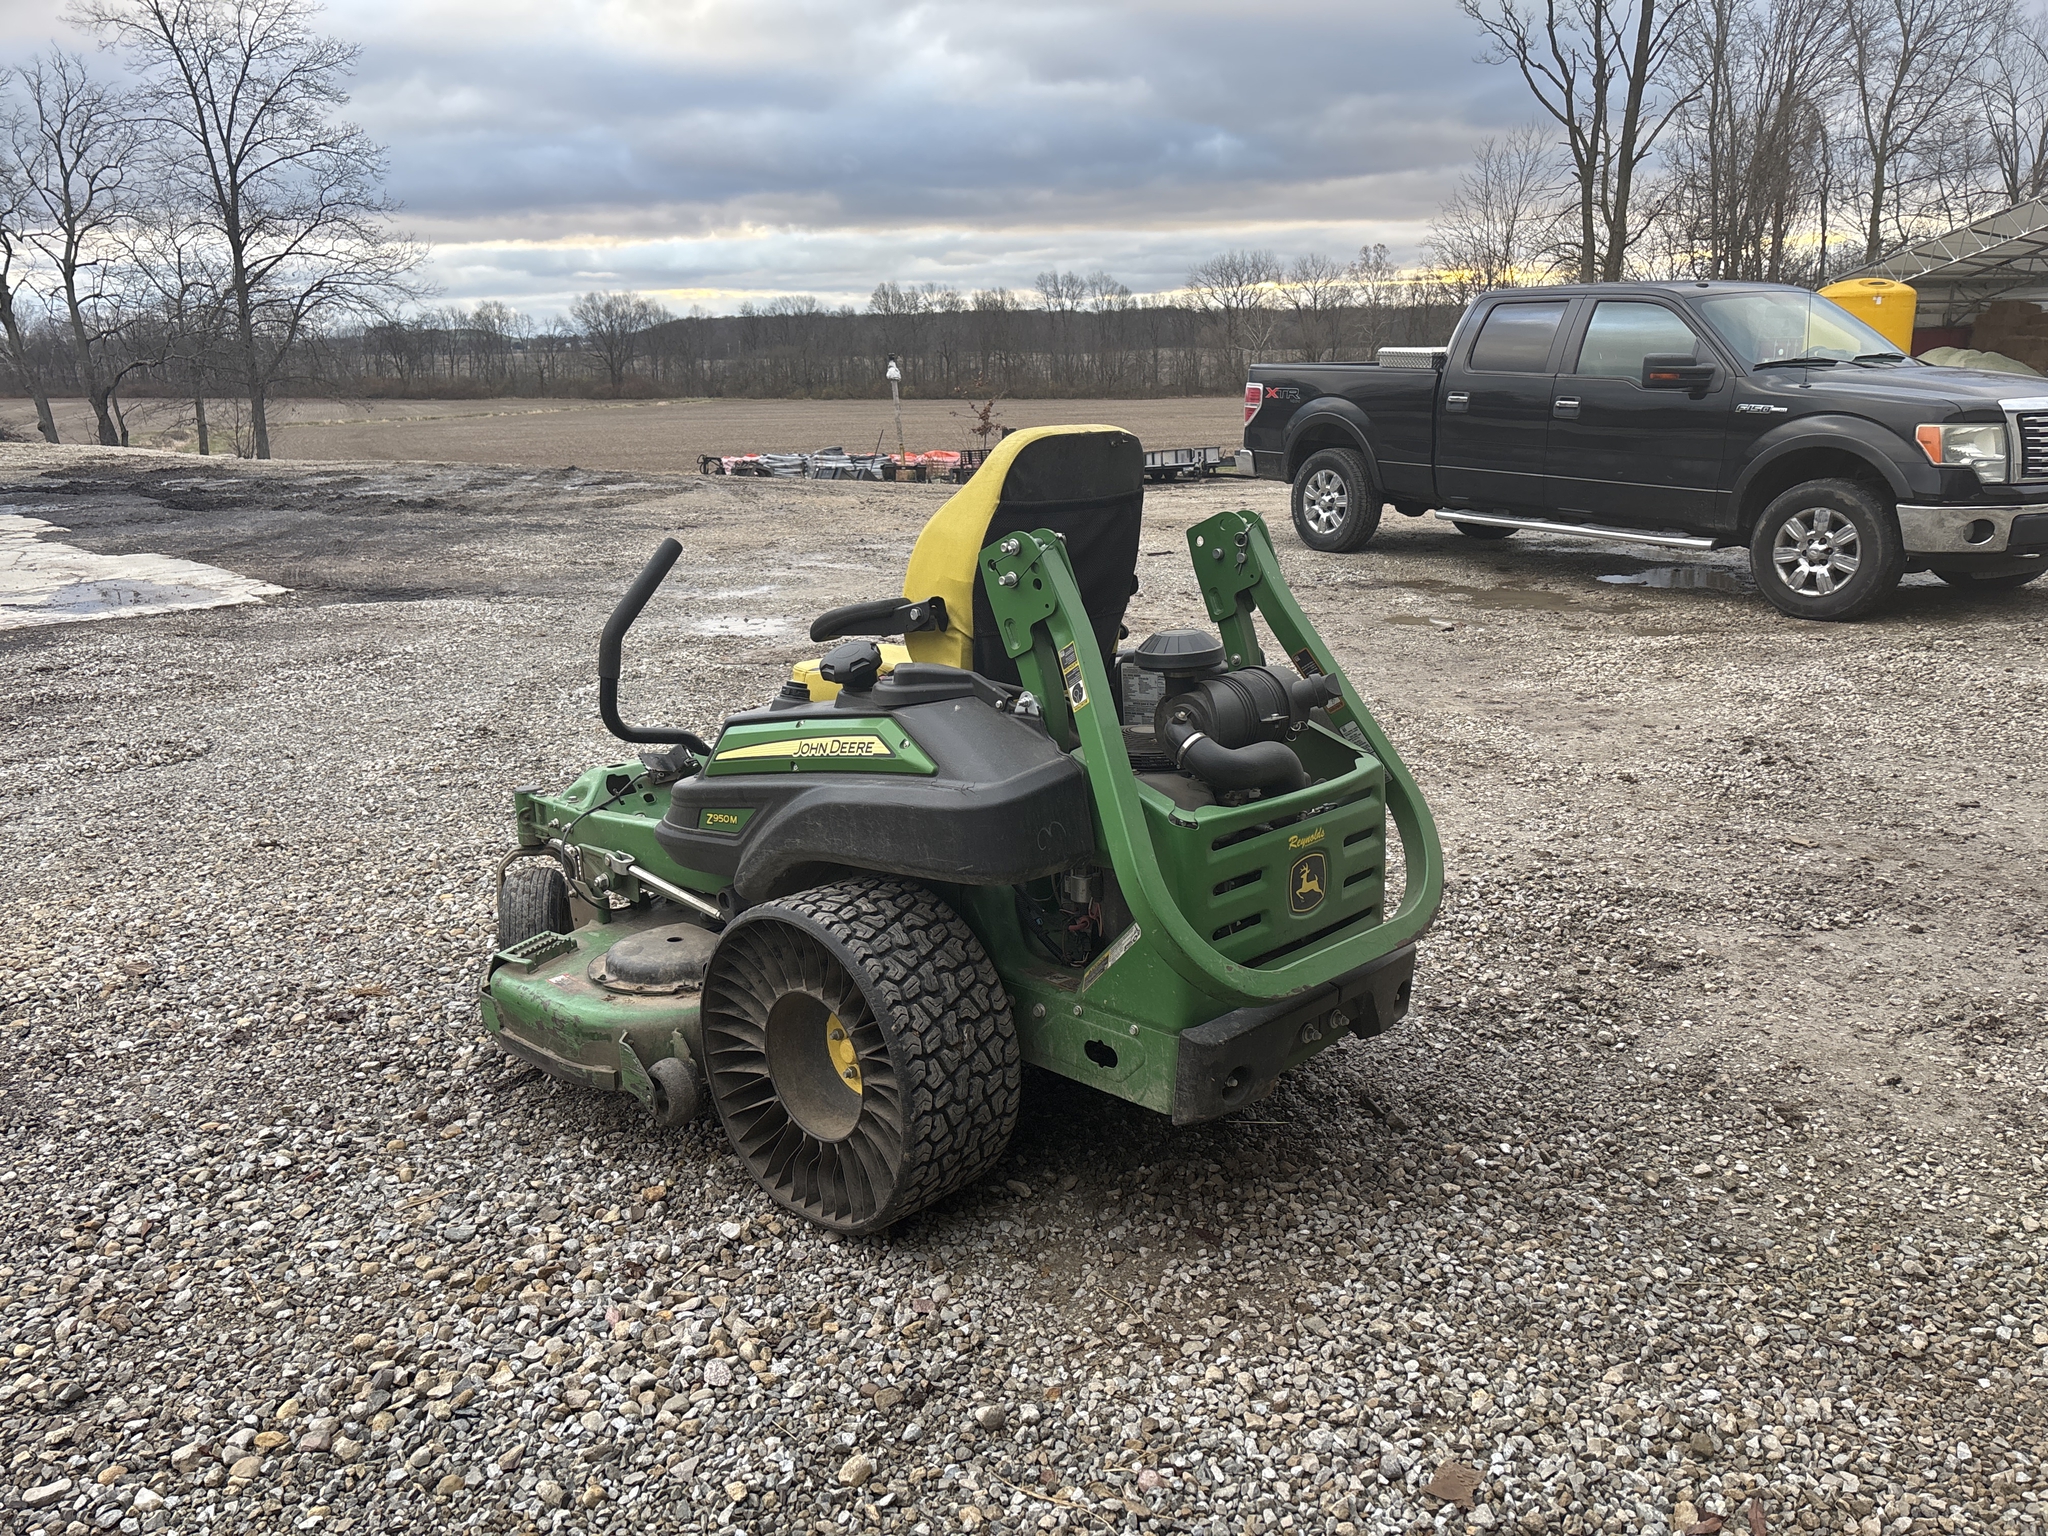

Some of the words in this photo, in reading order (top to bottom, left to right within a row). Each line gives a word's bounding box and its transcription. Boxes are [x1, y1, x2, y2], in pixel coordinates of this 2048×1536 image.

[1265, 386, 1300, 400] XTR
[793, 740, 829, 756] JOHN
[829, 739, 875, 755] DEERE
[706, 813, 738, 825] Z950M
[1288, 826, 1325, 850] Reynolds
